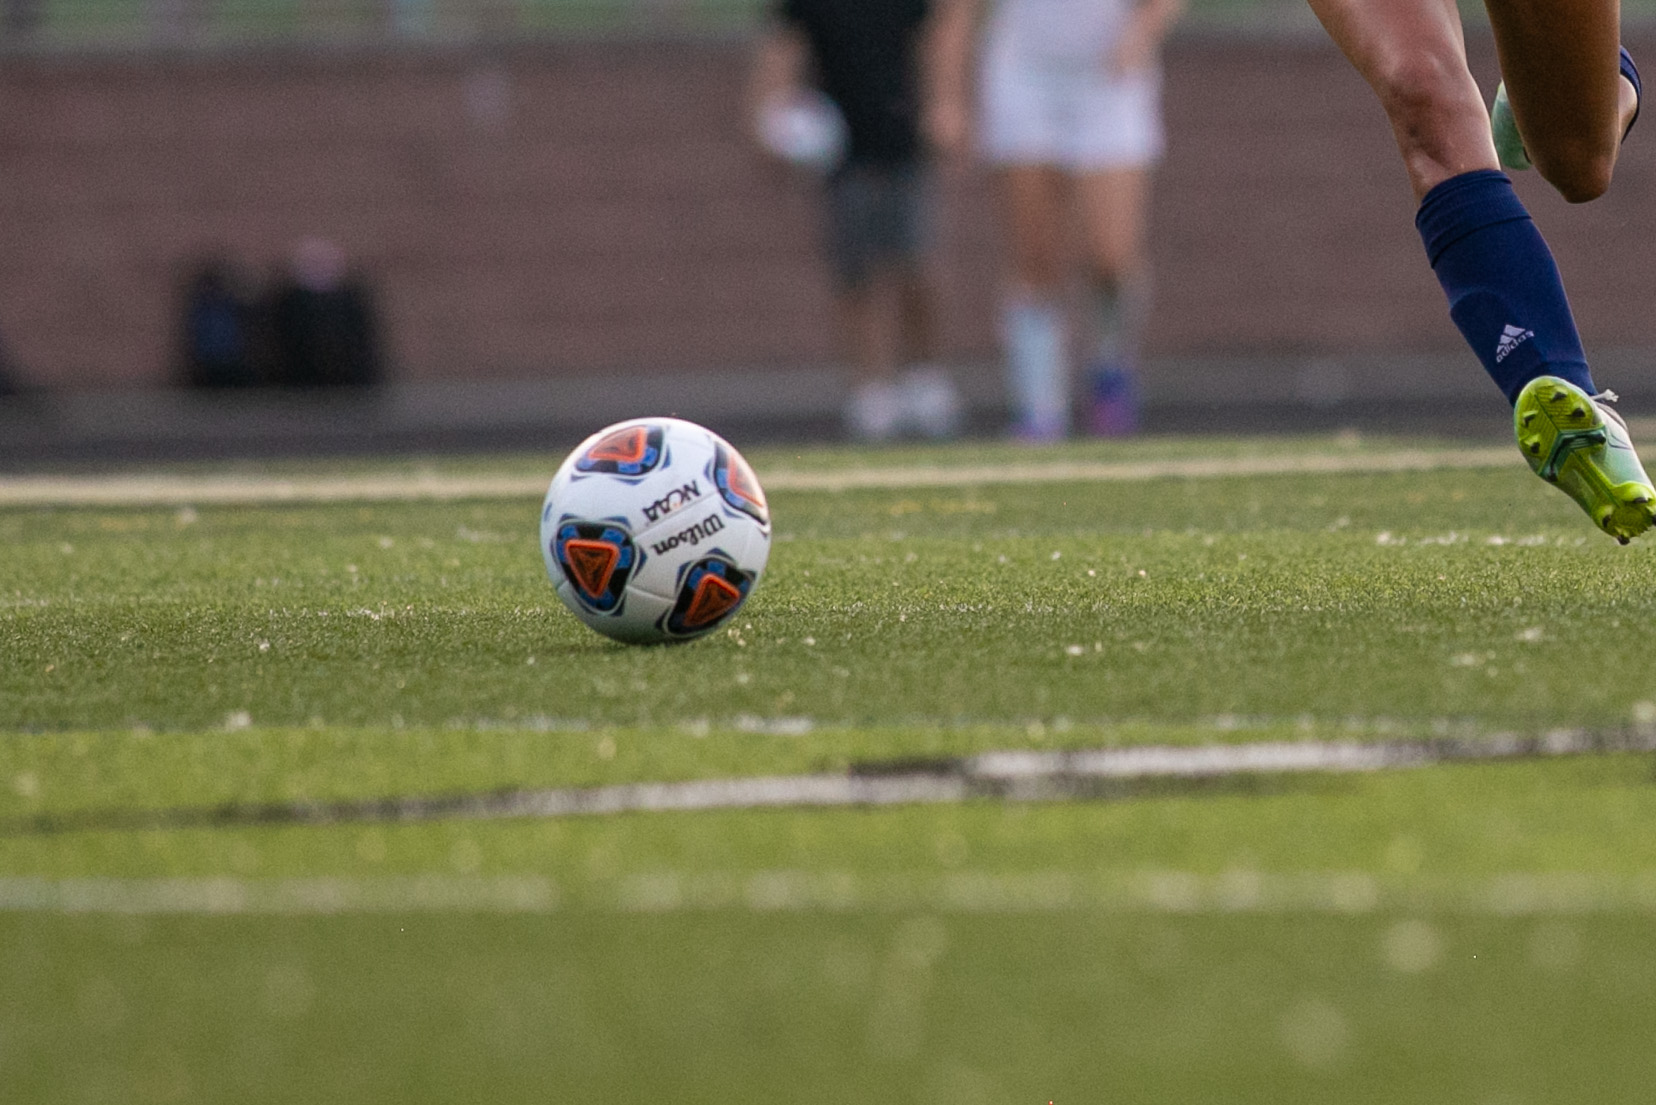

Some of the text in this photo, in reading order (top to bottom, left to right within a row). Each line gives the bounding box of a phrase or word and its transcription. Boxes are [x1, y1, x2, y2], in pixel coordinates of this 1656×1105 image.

[1496, 330, 1534, 363] adidas
[642, 479, 702, 522] NCAA
[651, 513, 725, 555] Wilson
